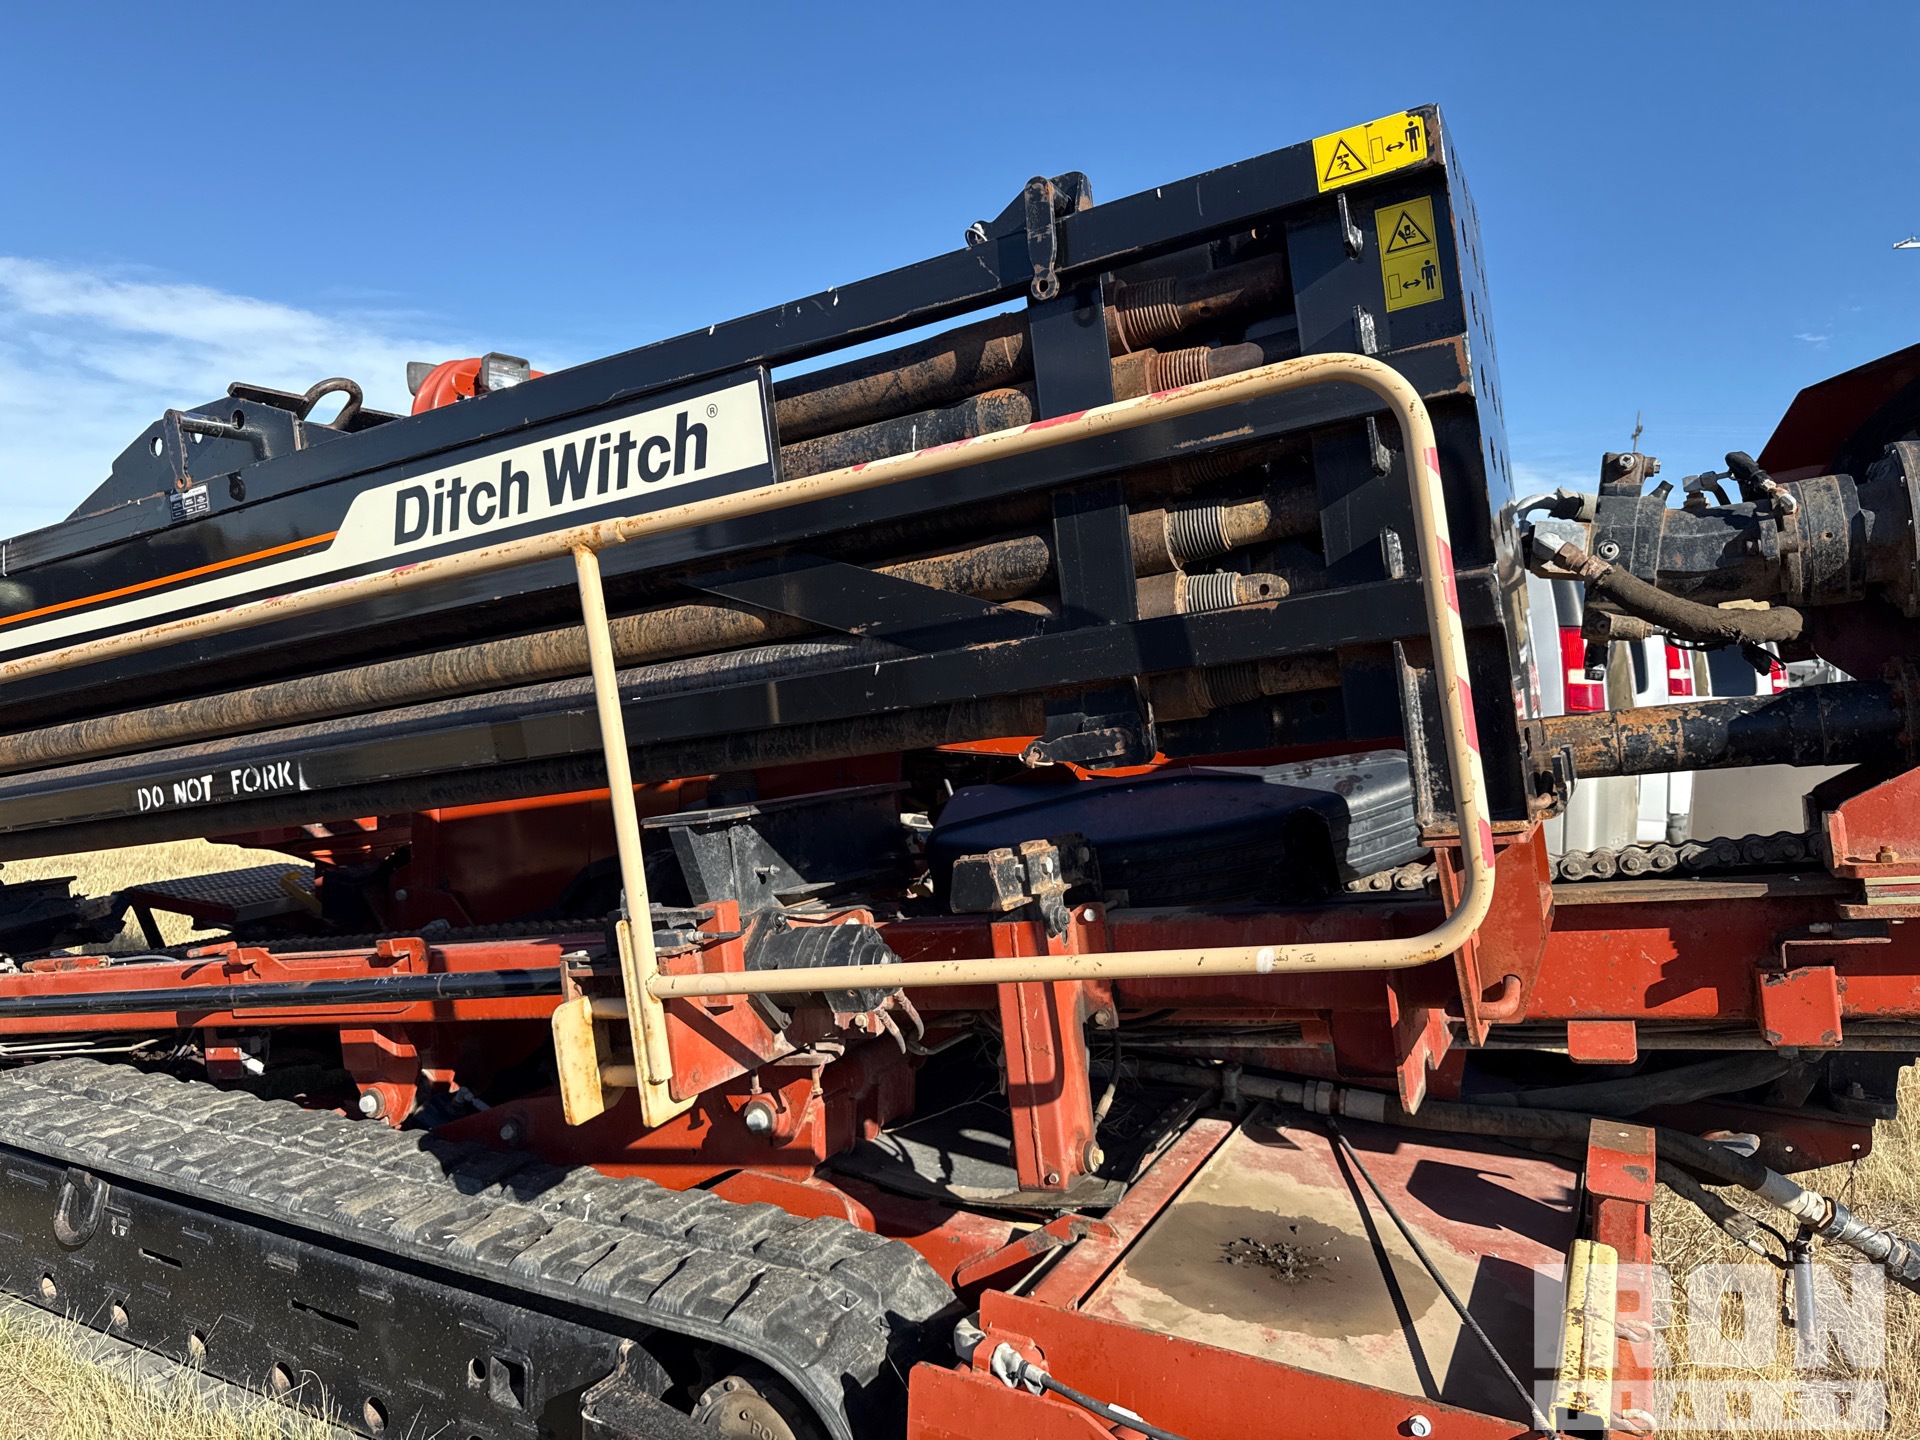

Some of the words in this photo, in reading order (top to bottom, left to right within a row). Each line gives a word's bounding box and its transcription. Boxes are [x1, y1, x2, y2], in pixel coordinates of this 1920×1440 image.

[394, 459, 529, 546] Ditch
[137, 786, 164, 811] DO
[173, 774, 213, 804] NOT
[231, 761, 294, 794] FORK
